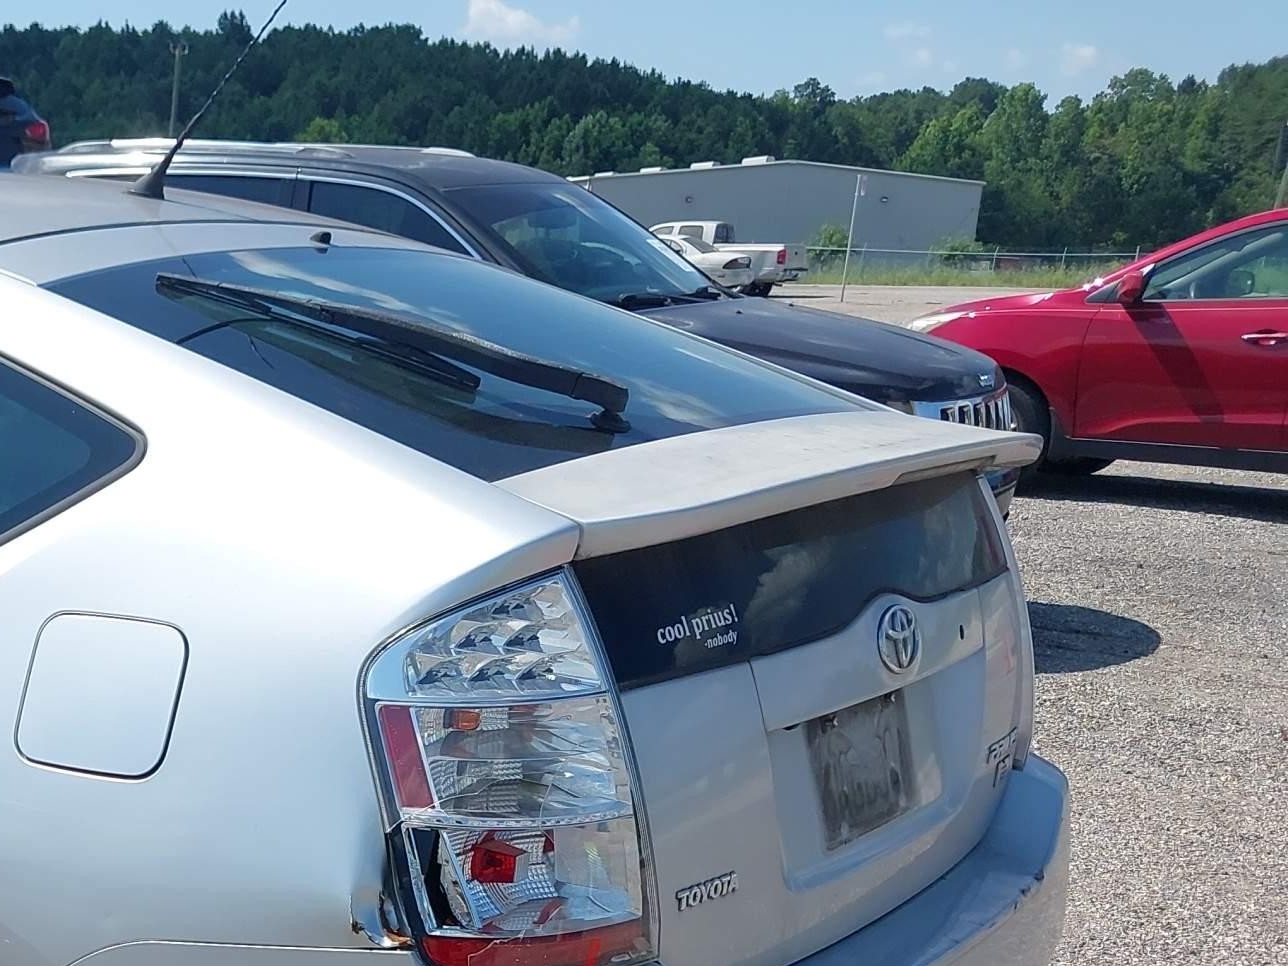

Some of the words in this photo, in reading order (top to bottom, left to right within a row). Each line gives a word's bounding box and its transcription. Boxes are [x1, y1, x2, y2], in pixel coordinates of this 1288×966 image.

[657, 615, 691, 644] cool
[692, 603, 738, 639] prius!
[675, 870, 737, 911] TOYOTA
